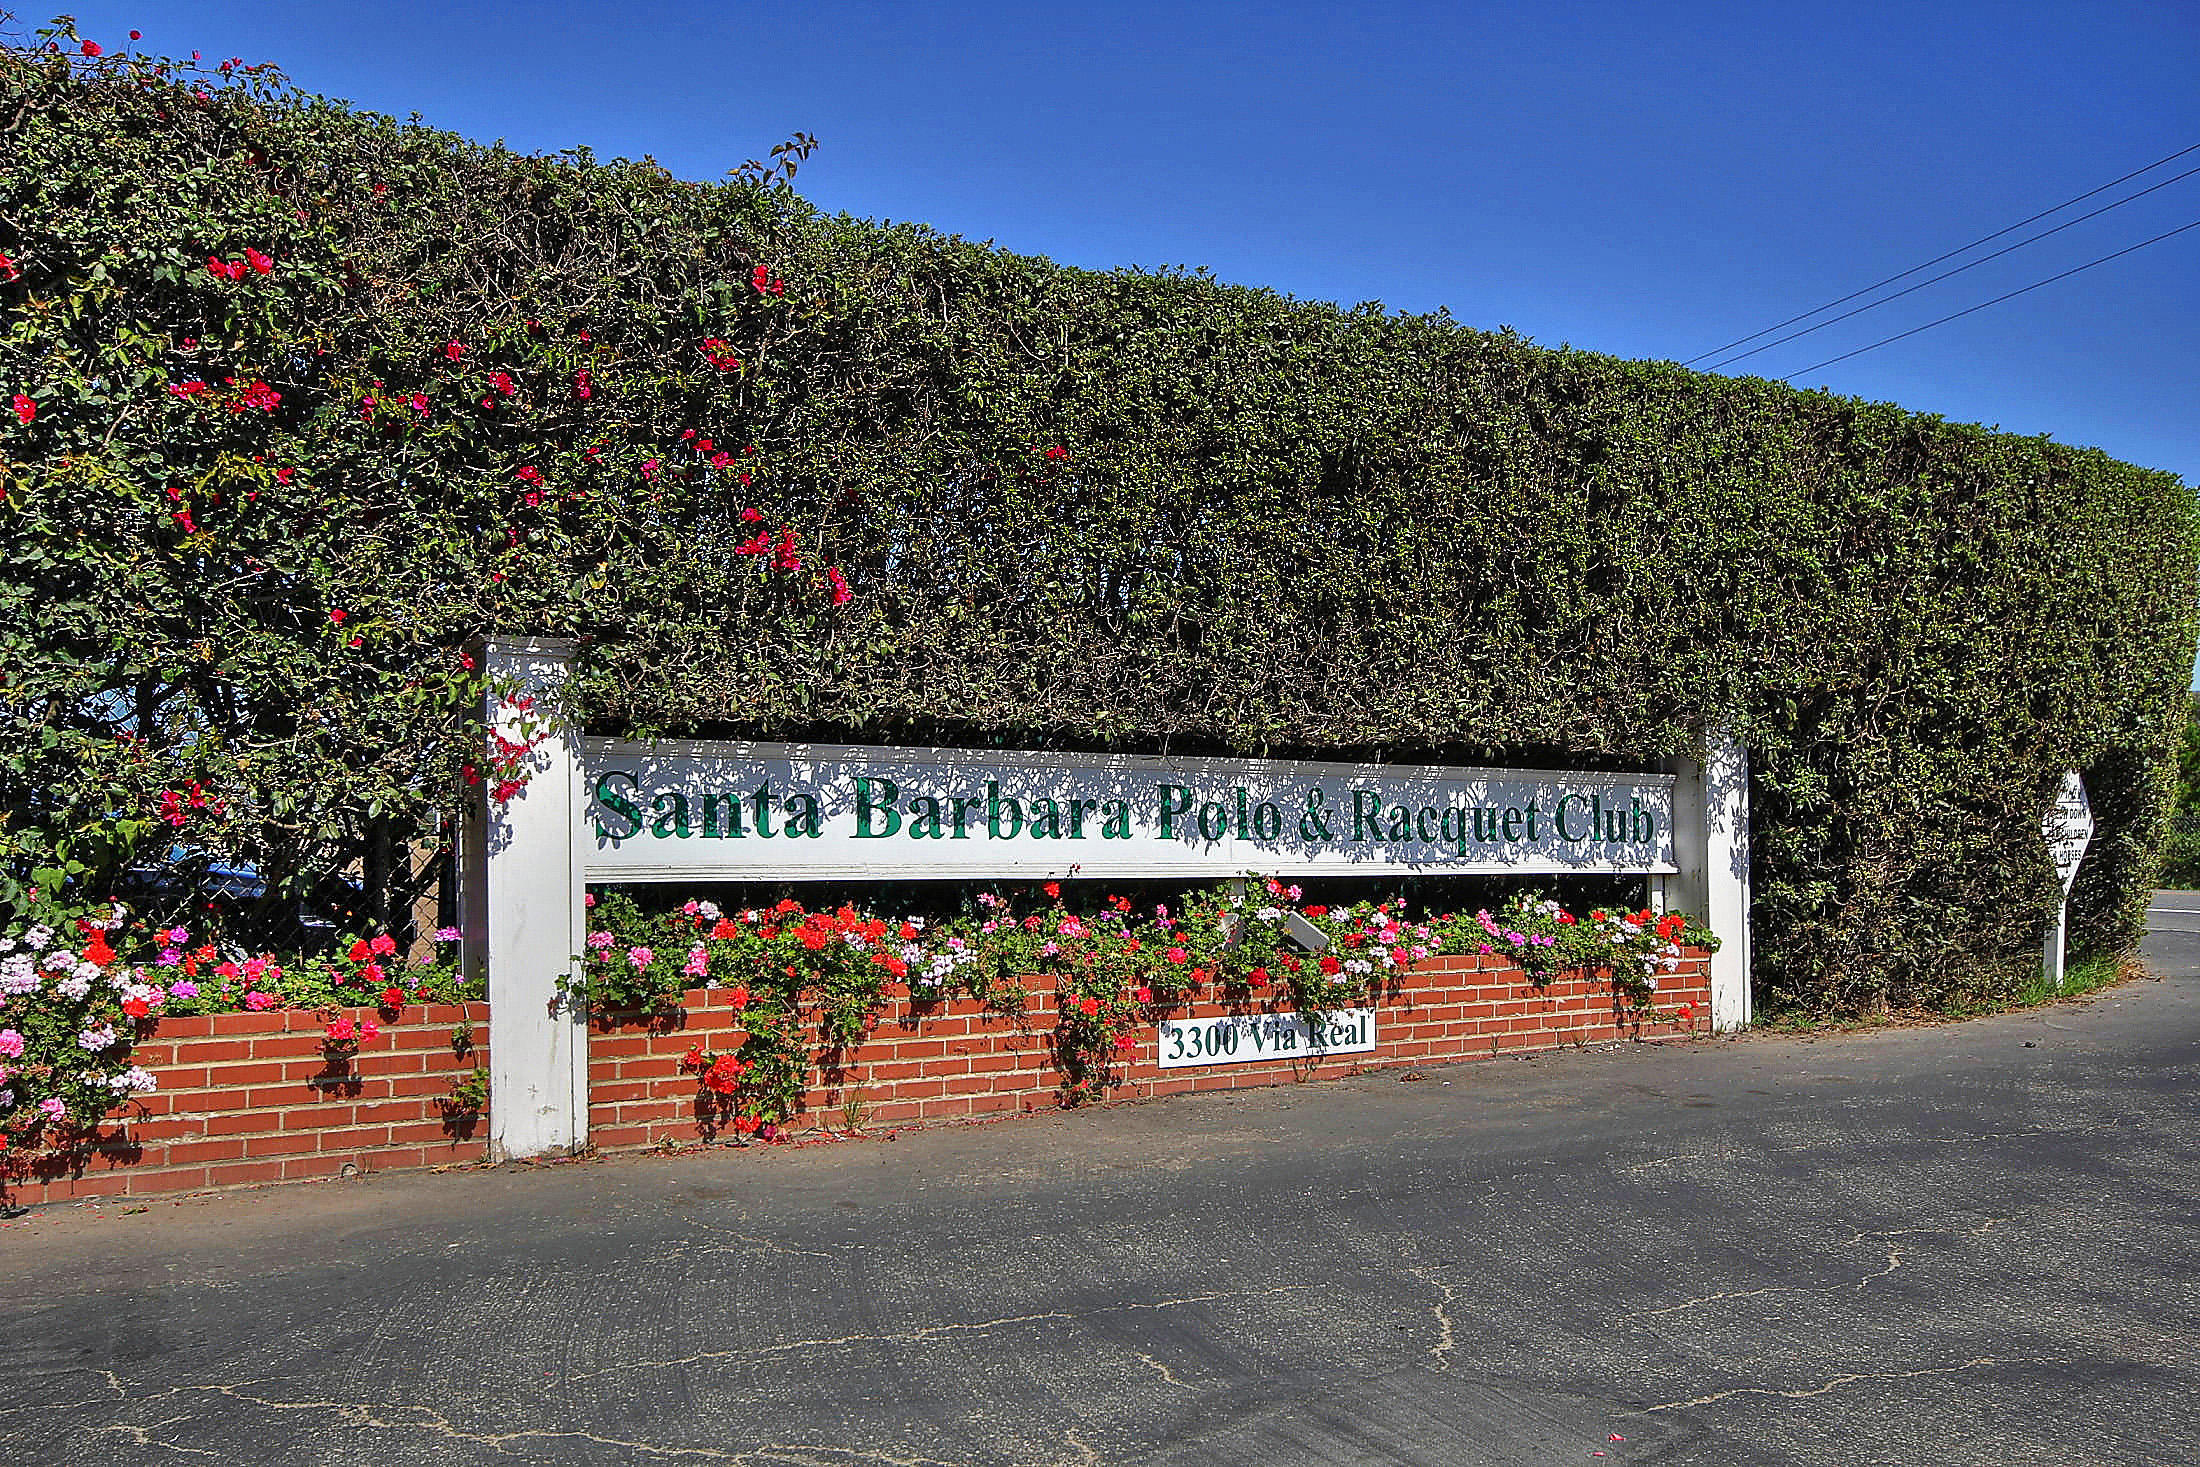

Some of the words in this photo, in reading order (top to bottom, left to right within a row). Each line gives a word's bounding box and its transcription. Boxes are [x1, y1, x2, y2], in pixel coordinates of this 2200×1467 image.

[595, 769, 824, 840] Santa
[849, 775, 1130, 841] Barbara
[1156, 783, 1282, 842] Polo
[1299, 786, 1336, 842] &
[1350, 788, 1540, 858] Racquet
[1555, 793, 1655, 844] Club
[1168, 1022, 1239, 1060] 3300
[1249, 1020, 1297, 1054] Via
[1308, 1013, 1367, 1049] Real
